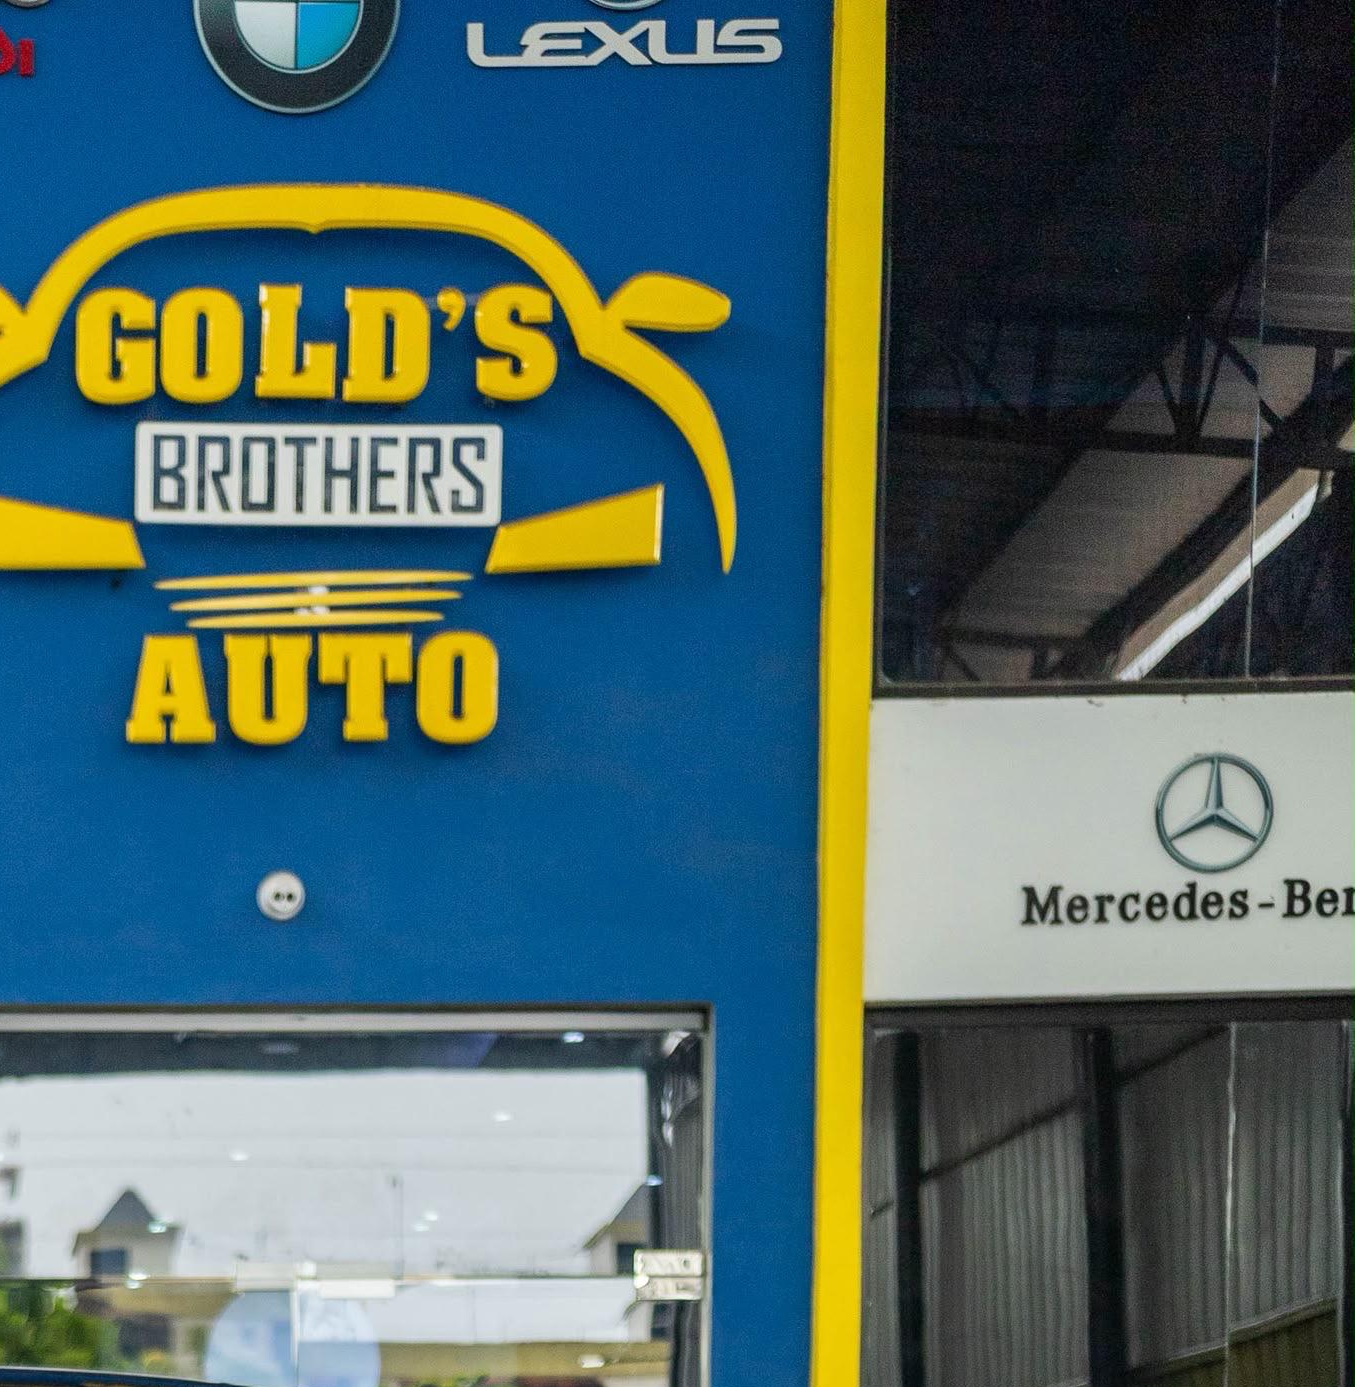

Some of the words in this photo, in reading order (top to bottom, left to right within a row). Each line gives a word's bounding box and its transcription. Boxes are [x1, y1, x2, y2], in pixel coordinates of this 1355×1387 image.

[467, 19, 783, 67] LEXUS
[75, 284, 559, 404] GOLD'S
[150, 434, 488, 516] BROTHERS
[125, 631, 499, 745] AUTO
